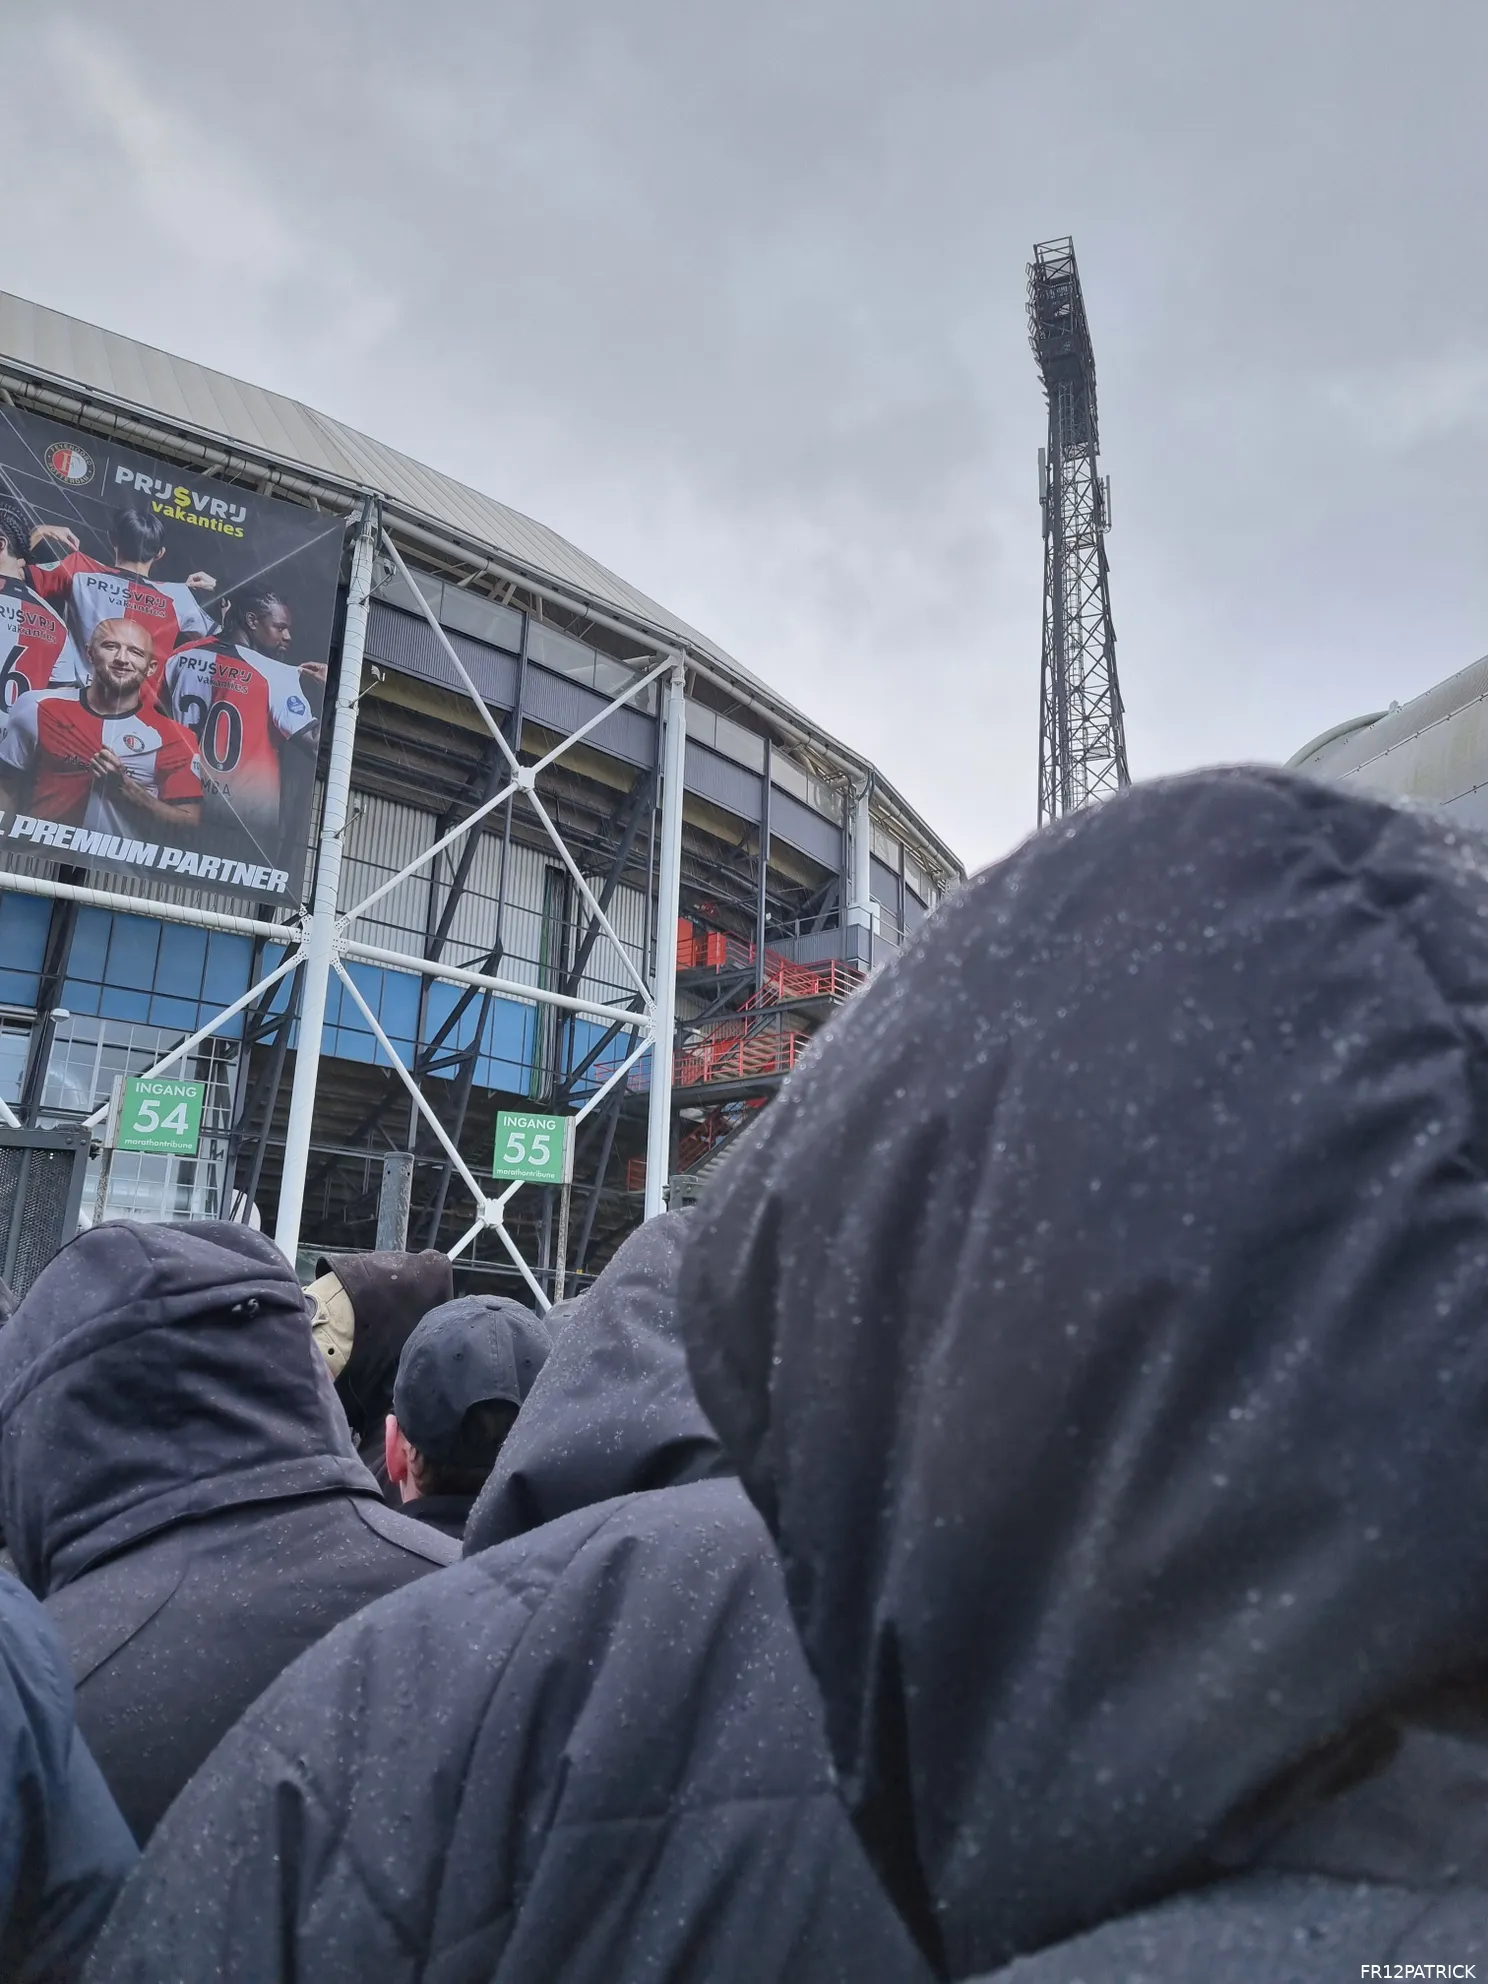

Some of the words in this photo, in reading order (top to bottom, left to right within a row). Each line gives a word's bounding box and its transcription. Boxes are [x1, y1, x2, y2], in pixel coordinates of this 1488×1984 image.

[151, 500, 244, 538] vakanties
[108, 596, 168, 618] vakanties
[7, 623, 58, 645] vakanties
[197, 674, 249, 694] vakanties
[8, 814, 159, 867] PREMIUM
[156, 846, 289, 894] PARTNER
[135, 1082, 197, 1098] INGANG
[132, 1099, 189, 1135] 54
[503, 1115, 556, 1131] INGANG
[124, 1138, 193, 1149] marathontribune
[502, 1132, 551, 1166] 55
[496, 1168, 555, 1179] marathontribune
